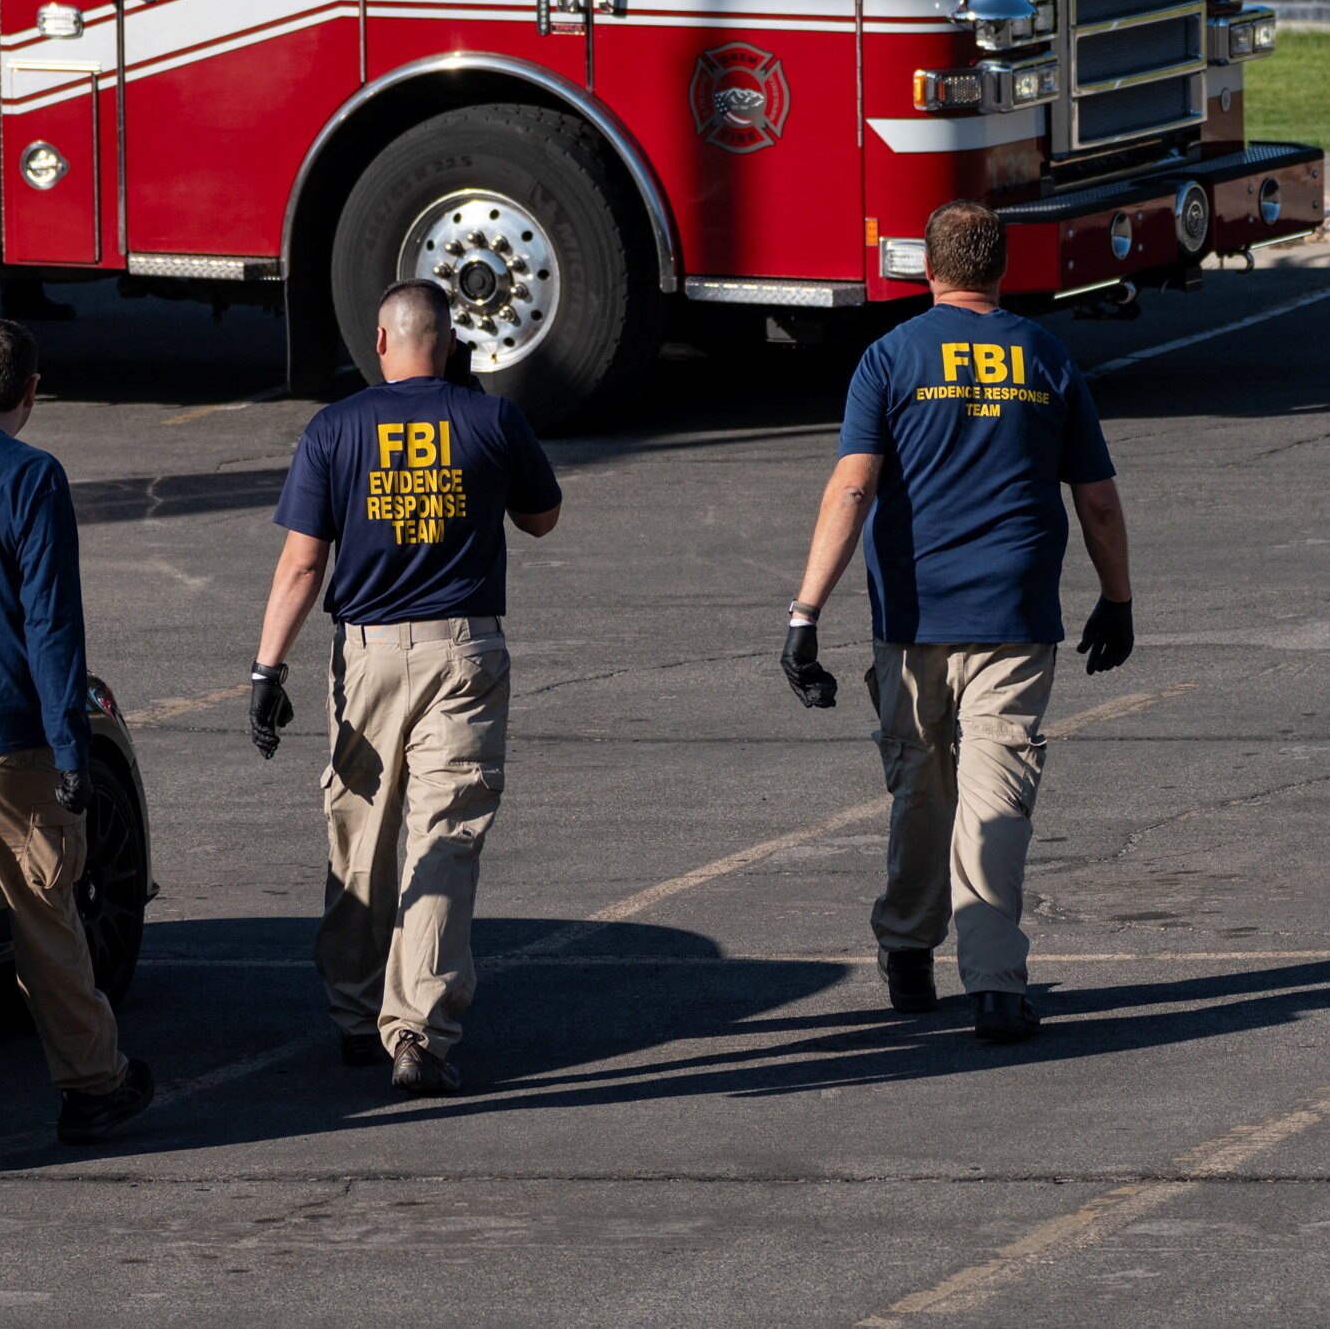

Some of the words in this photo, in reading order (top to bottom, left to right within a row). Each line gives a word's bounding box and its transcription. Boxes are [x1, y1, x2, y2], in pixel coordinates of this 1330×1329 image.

[941, 342, 1026, 385] FBI
[916, 385, 981, 401] EVIDENCE
[983, 386, 1050, 405] RESPONSE
[966, 403, 1001, 417] TEAM
[377, 420, 451, 469] FBI
[369, 468, 463, 495] EVIDENCE
[366, 494, 467, 521] RESPONSE
[391, 518, 445, 545] TEAM
